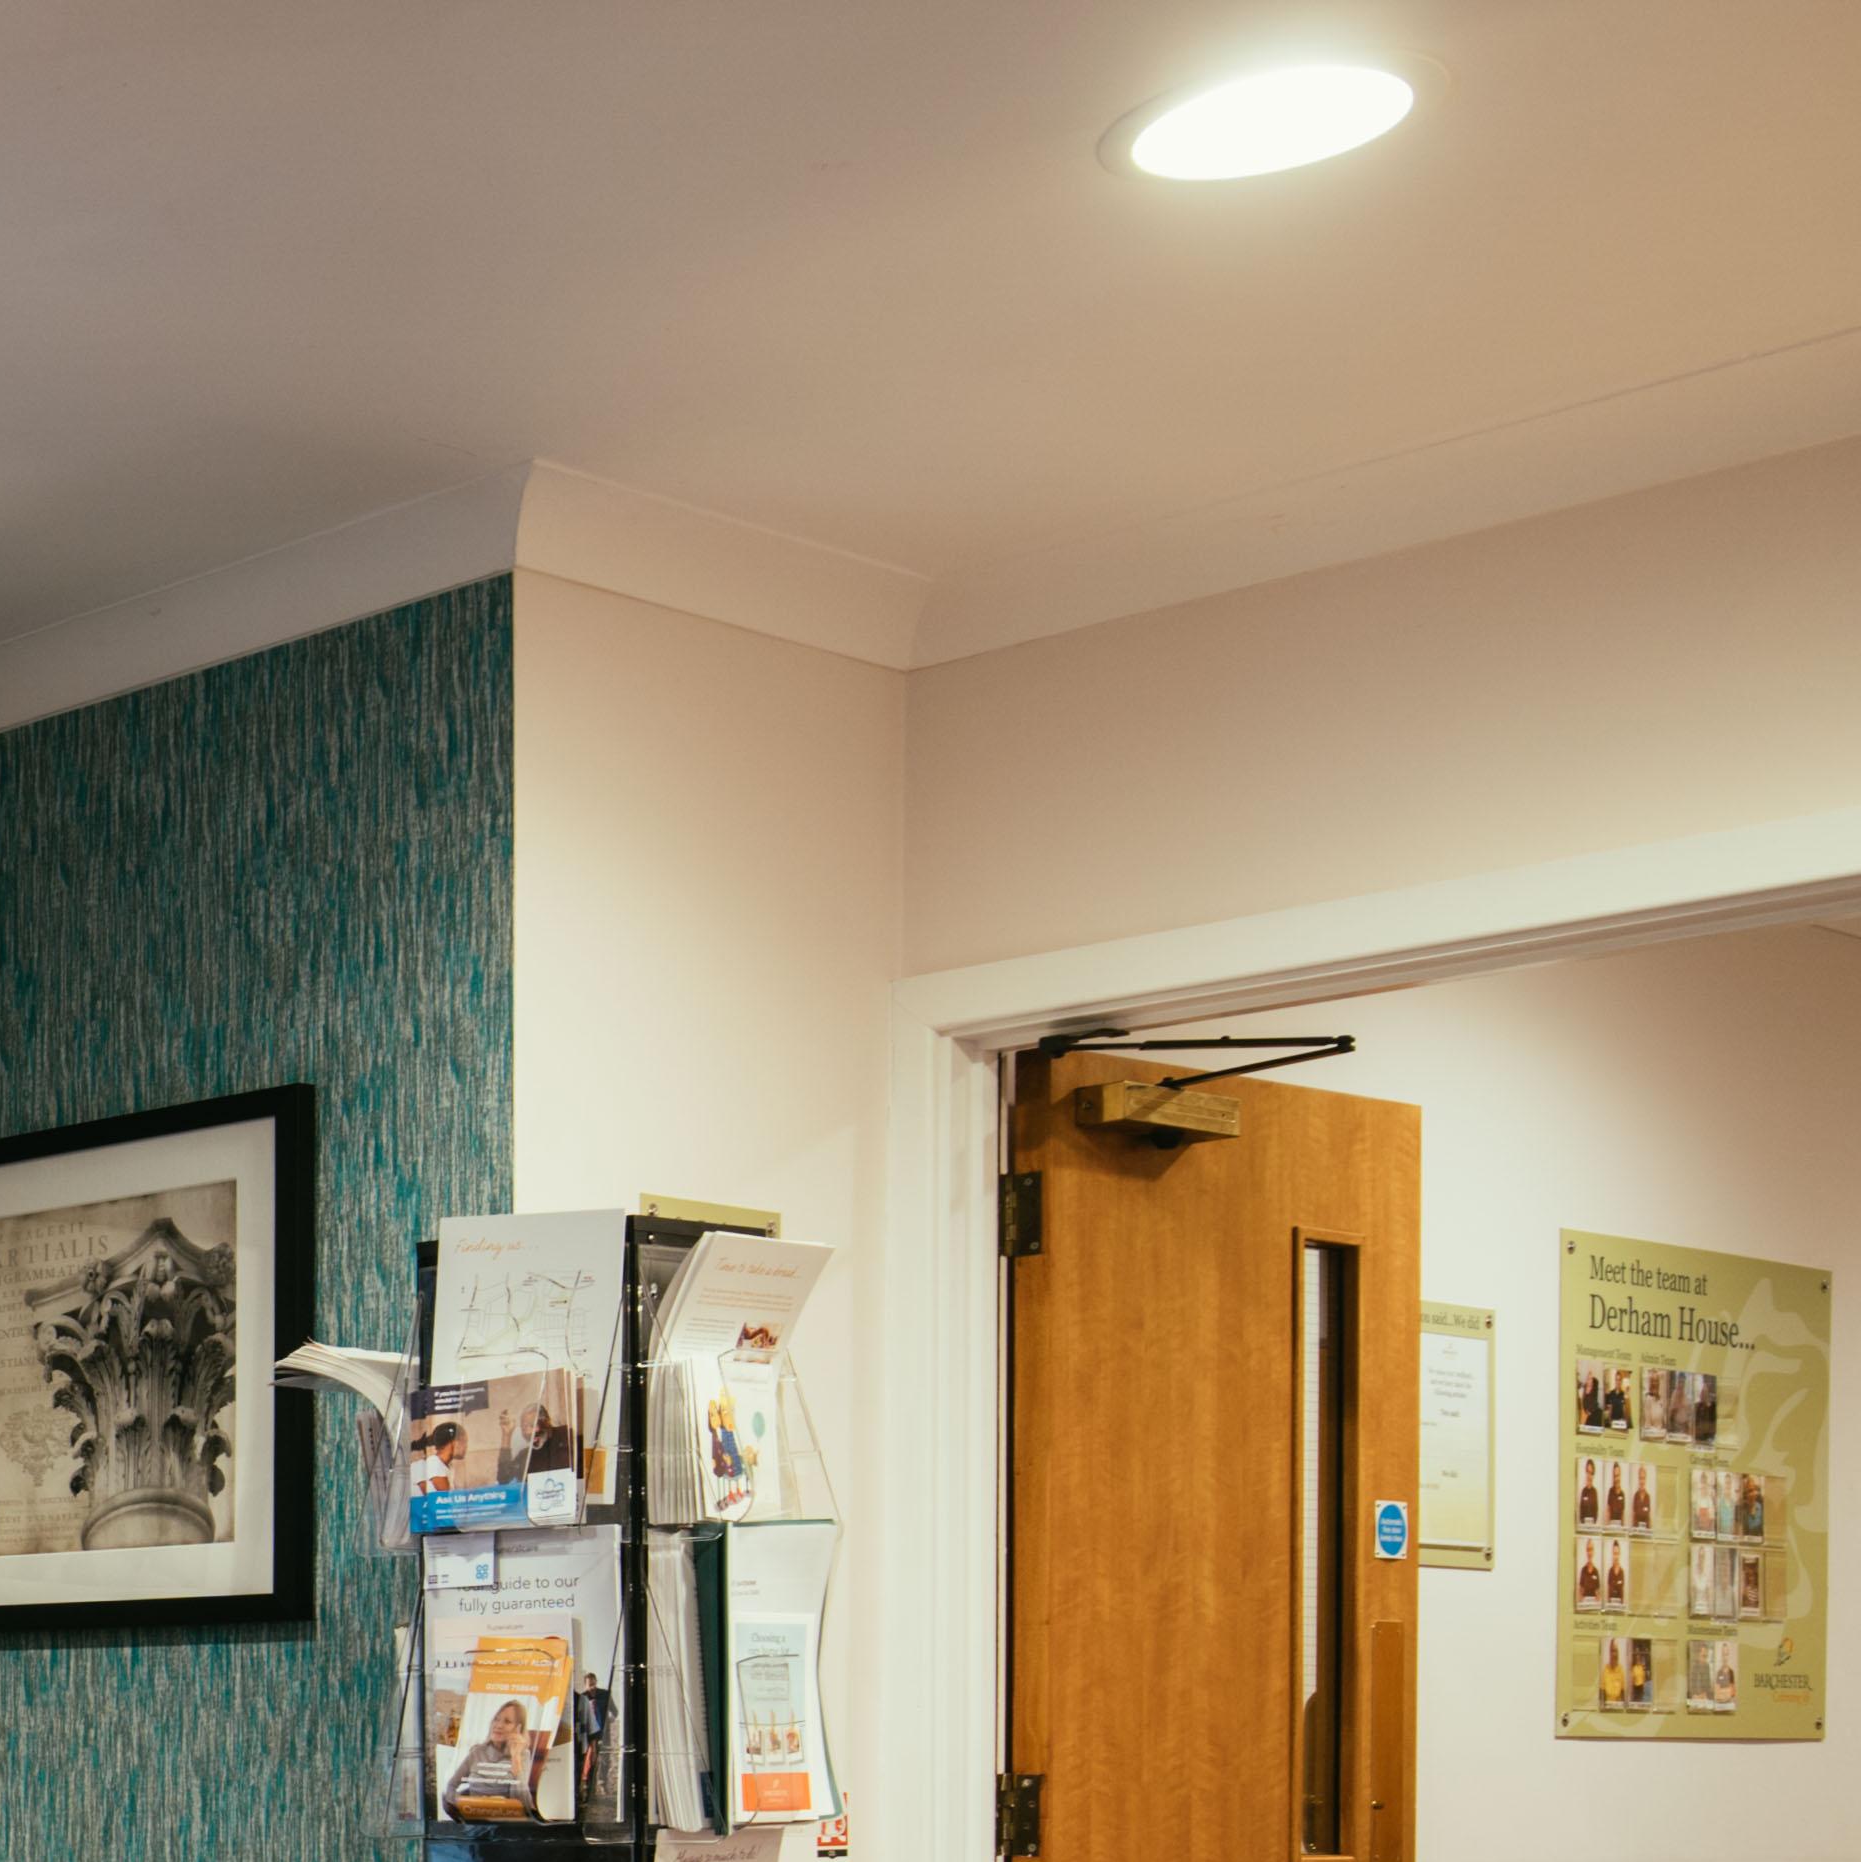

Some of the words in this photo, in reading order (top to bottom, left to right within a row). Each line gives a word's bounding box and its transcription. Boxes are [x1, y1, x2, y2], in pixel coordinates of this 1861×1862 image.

[1589, 1254, 1627, 1285] Meet
[1630, 1259, 1654, 1288] the
[1657, 1267, 1691, 1294] team
[1694, 1274, 1709, 1296] at
[1589, 1293, 1672, 1340] Derham
[1678, 1306, 1756, 1350] House...
[435, 1494, 453, 1505] Ask
[454, 1492, 466, 1503] Us
[468, 1490, 507, 1502] Anything
[492, 1577, 531, 1594] guide
[535, 1578, 550, 1589] to
[554, 1576, 580, 1588] our
[459, 1597, 488, 1615] fully
[492, 1594, 575, 1614] guaranteed
[1754, 1673, 1814, 1691] BARCHESTER
